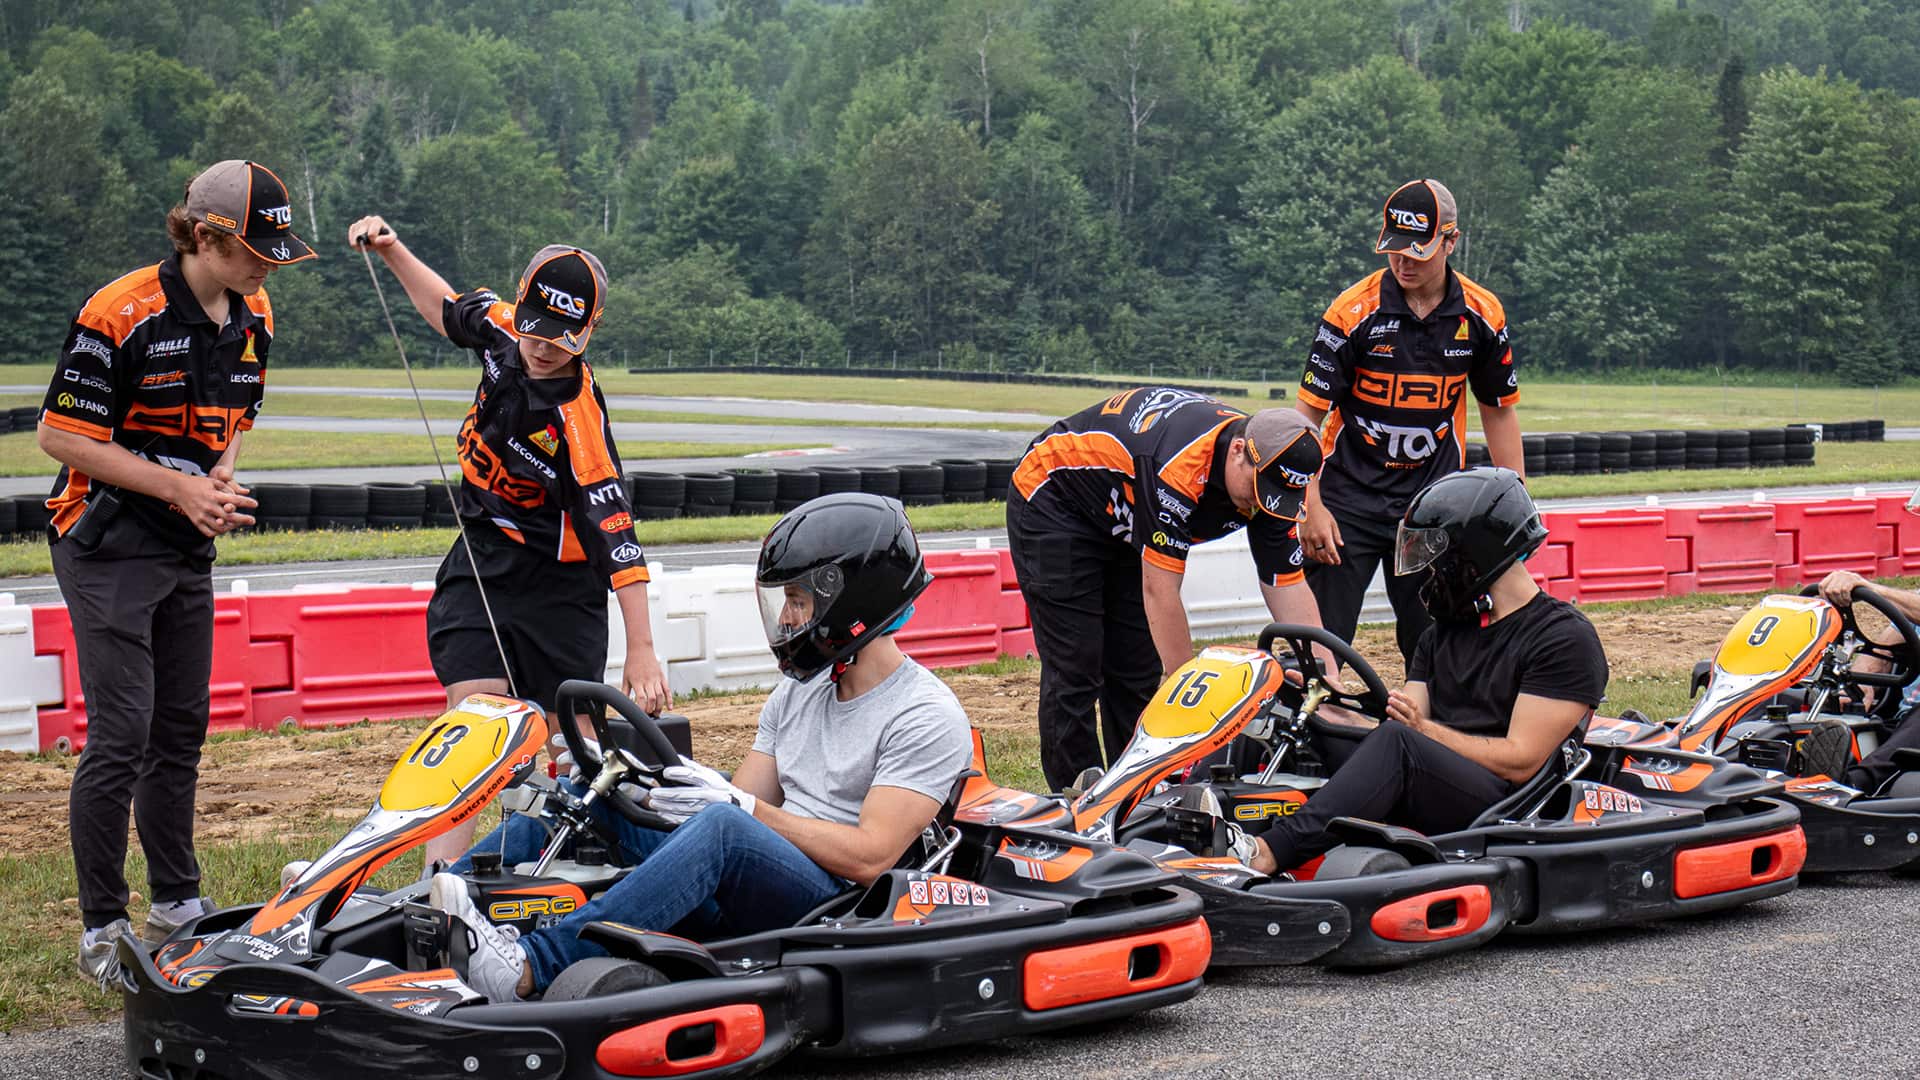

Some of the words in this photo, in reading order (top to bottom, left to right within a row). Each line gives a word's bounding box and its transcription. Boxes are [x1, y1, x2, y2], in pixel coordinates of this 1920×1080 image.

[57, 392, 109, 416] ALFANO
[1746, 615, 1781, 647] 9
[1165, 668, 1221, 708] 15
[408, 722, 470, 767] 13
[450, 774, 506, 824] kartcrg.com
[1234, 801, 1301, 822] CRG
[489, 895, 577, 922] CRG
